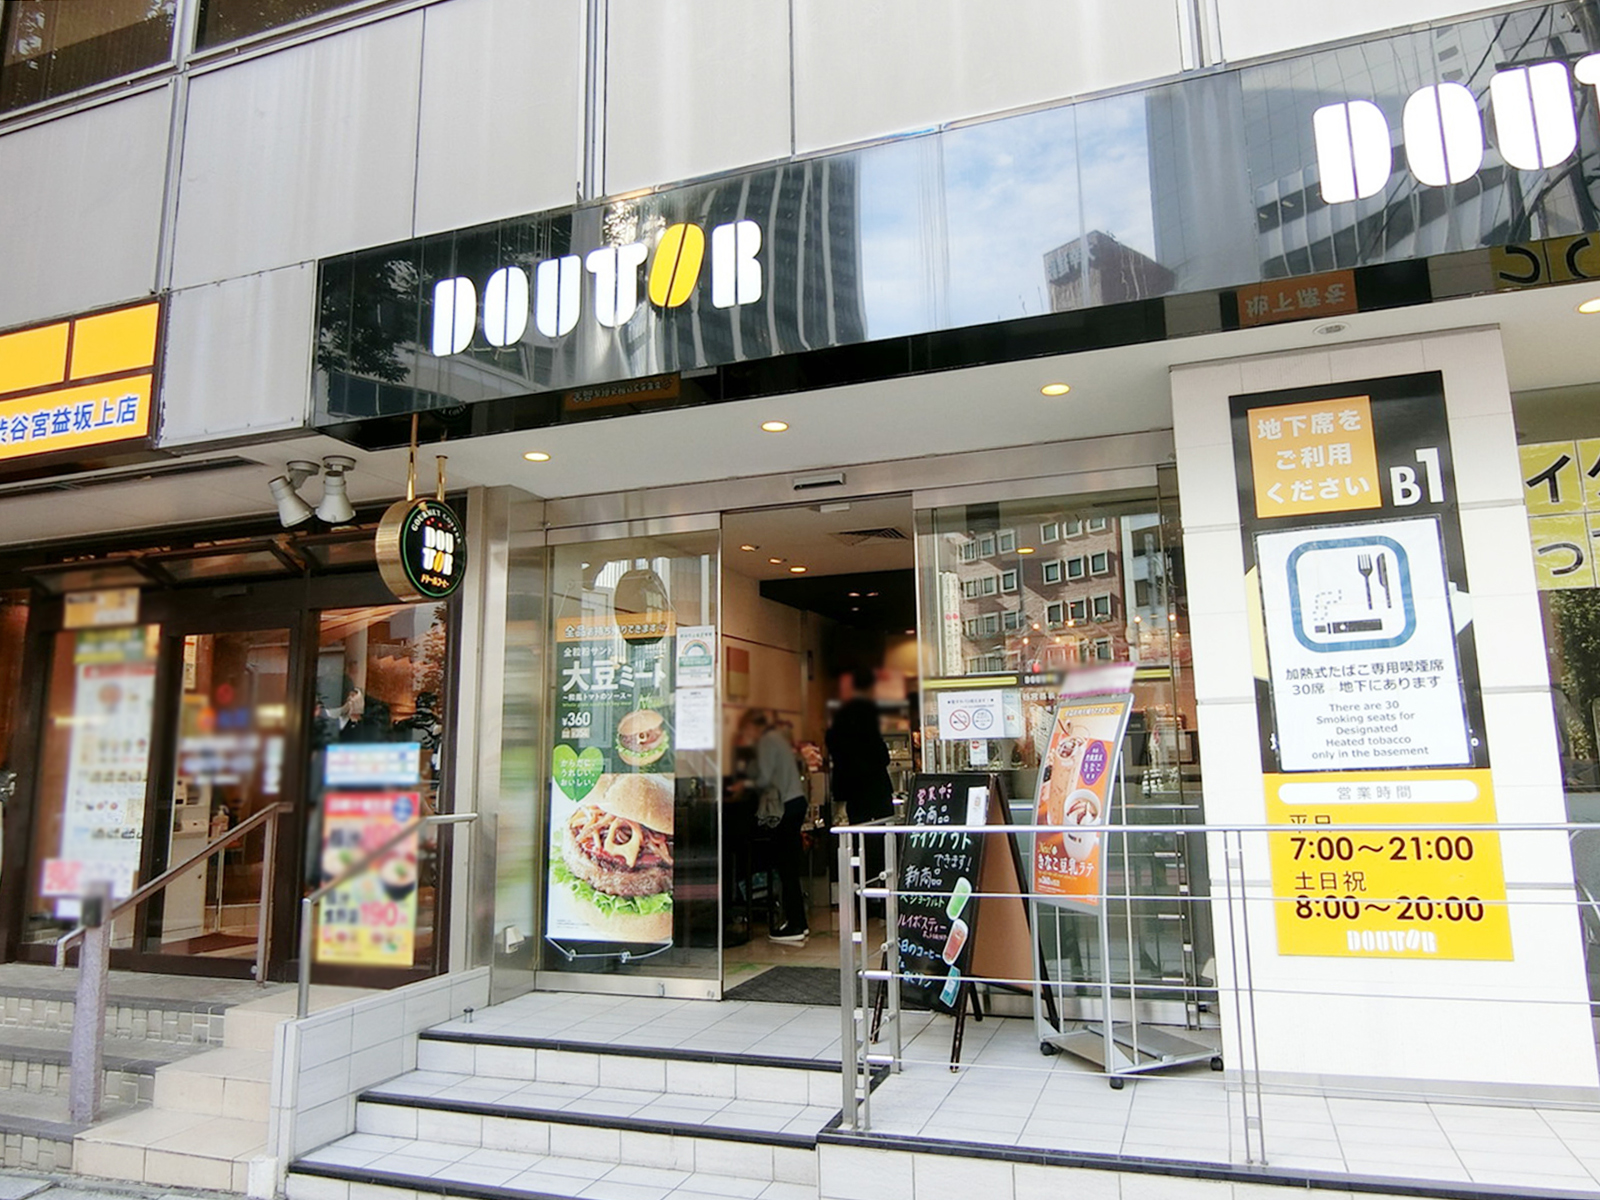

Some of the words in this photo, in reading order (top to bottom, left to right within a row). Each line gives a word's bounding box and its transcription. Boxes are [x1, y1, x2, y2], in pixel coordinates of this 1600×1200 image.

[433, 220, 762, 357] DOUTOR
[1257, 408, 1363, 440] 地下席を
[1275, 443, 1353, 470] ご利用
[1389, 447, 1445, 506] B1
[1266, 475, 1371, 505] ください
[562, 660, 667, 692] 大豆ミート
[1286, 659, 1445, 681] 加熱式たばこ専用喫煙席
[1292, 683, 1325, 696] 30席
[1339, 675, 1441, 693] 地下にあります
[1329, 703, 1360, 712] There
[1363, 703, 1382, 711] are
[1385, 701, 1399, 709] 30
[562, 712, 591, 726] ¥360
[1316, 713, 1364, 725] Smoking
[1367, 712, 1396, 722] seats
[1399, 711, 1415, 720] for
[1326, 737, 1364, 747] Heated
[1367, 735, 1412, 745] tobacco
[1336, 724, 1398, 736] Designated
[1312, 749, 1335, 760] only
[1338, 749, 1348, 758] in
[1351, 748, 1370, 757] the
[1373, 746, 1429, 757] basement
[1337, 785, 1413, 801] 営業時間
[1038, 854, 1094, 878] きなこ豆乳ラテ
[1295, 871, 1367, 893] 土日祝
[898, 937, 942, 959] 日のコーヒー
[1347, 929, 1438, 953] DOUTOR
